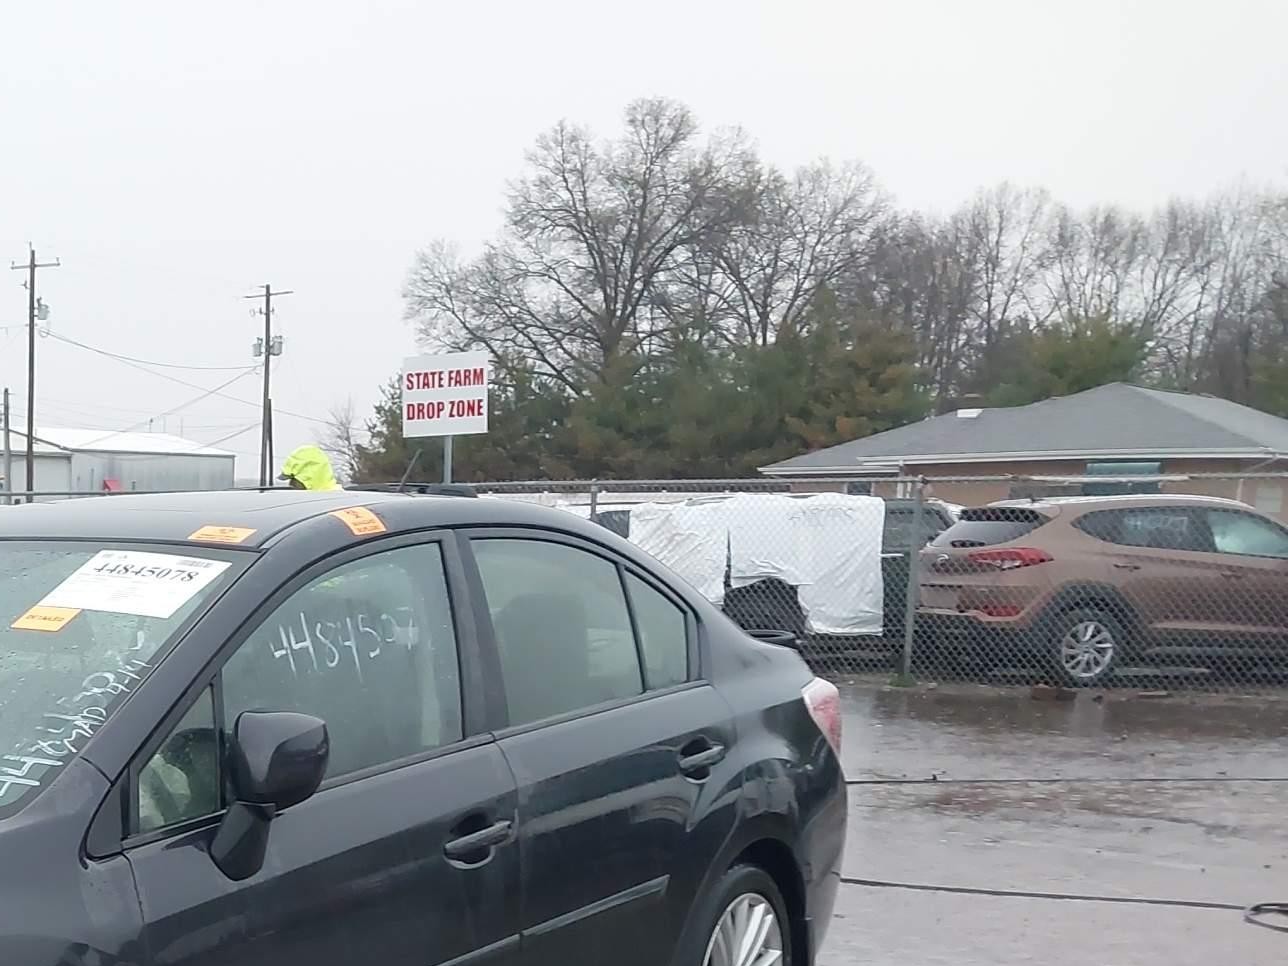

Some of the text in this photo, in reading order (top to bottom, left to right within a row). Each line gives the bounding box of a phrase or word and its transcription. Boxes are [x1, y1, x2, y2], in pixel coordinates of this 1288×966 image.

[406, 367, 484, 390] STATE FARM
[406, 398, 484, 421] DROP ZONE
[93, 562, 199, 582] 44845078
